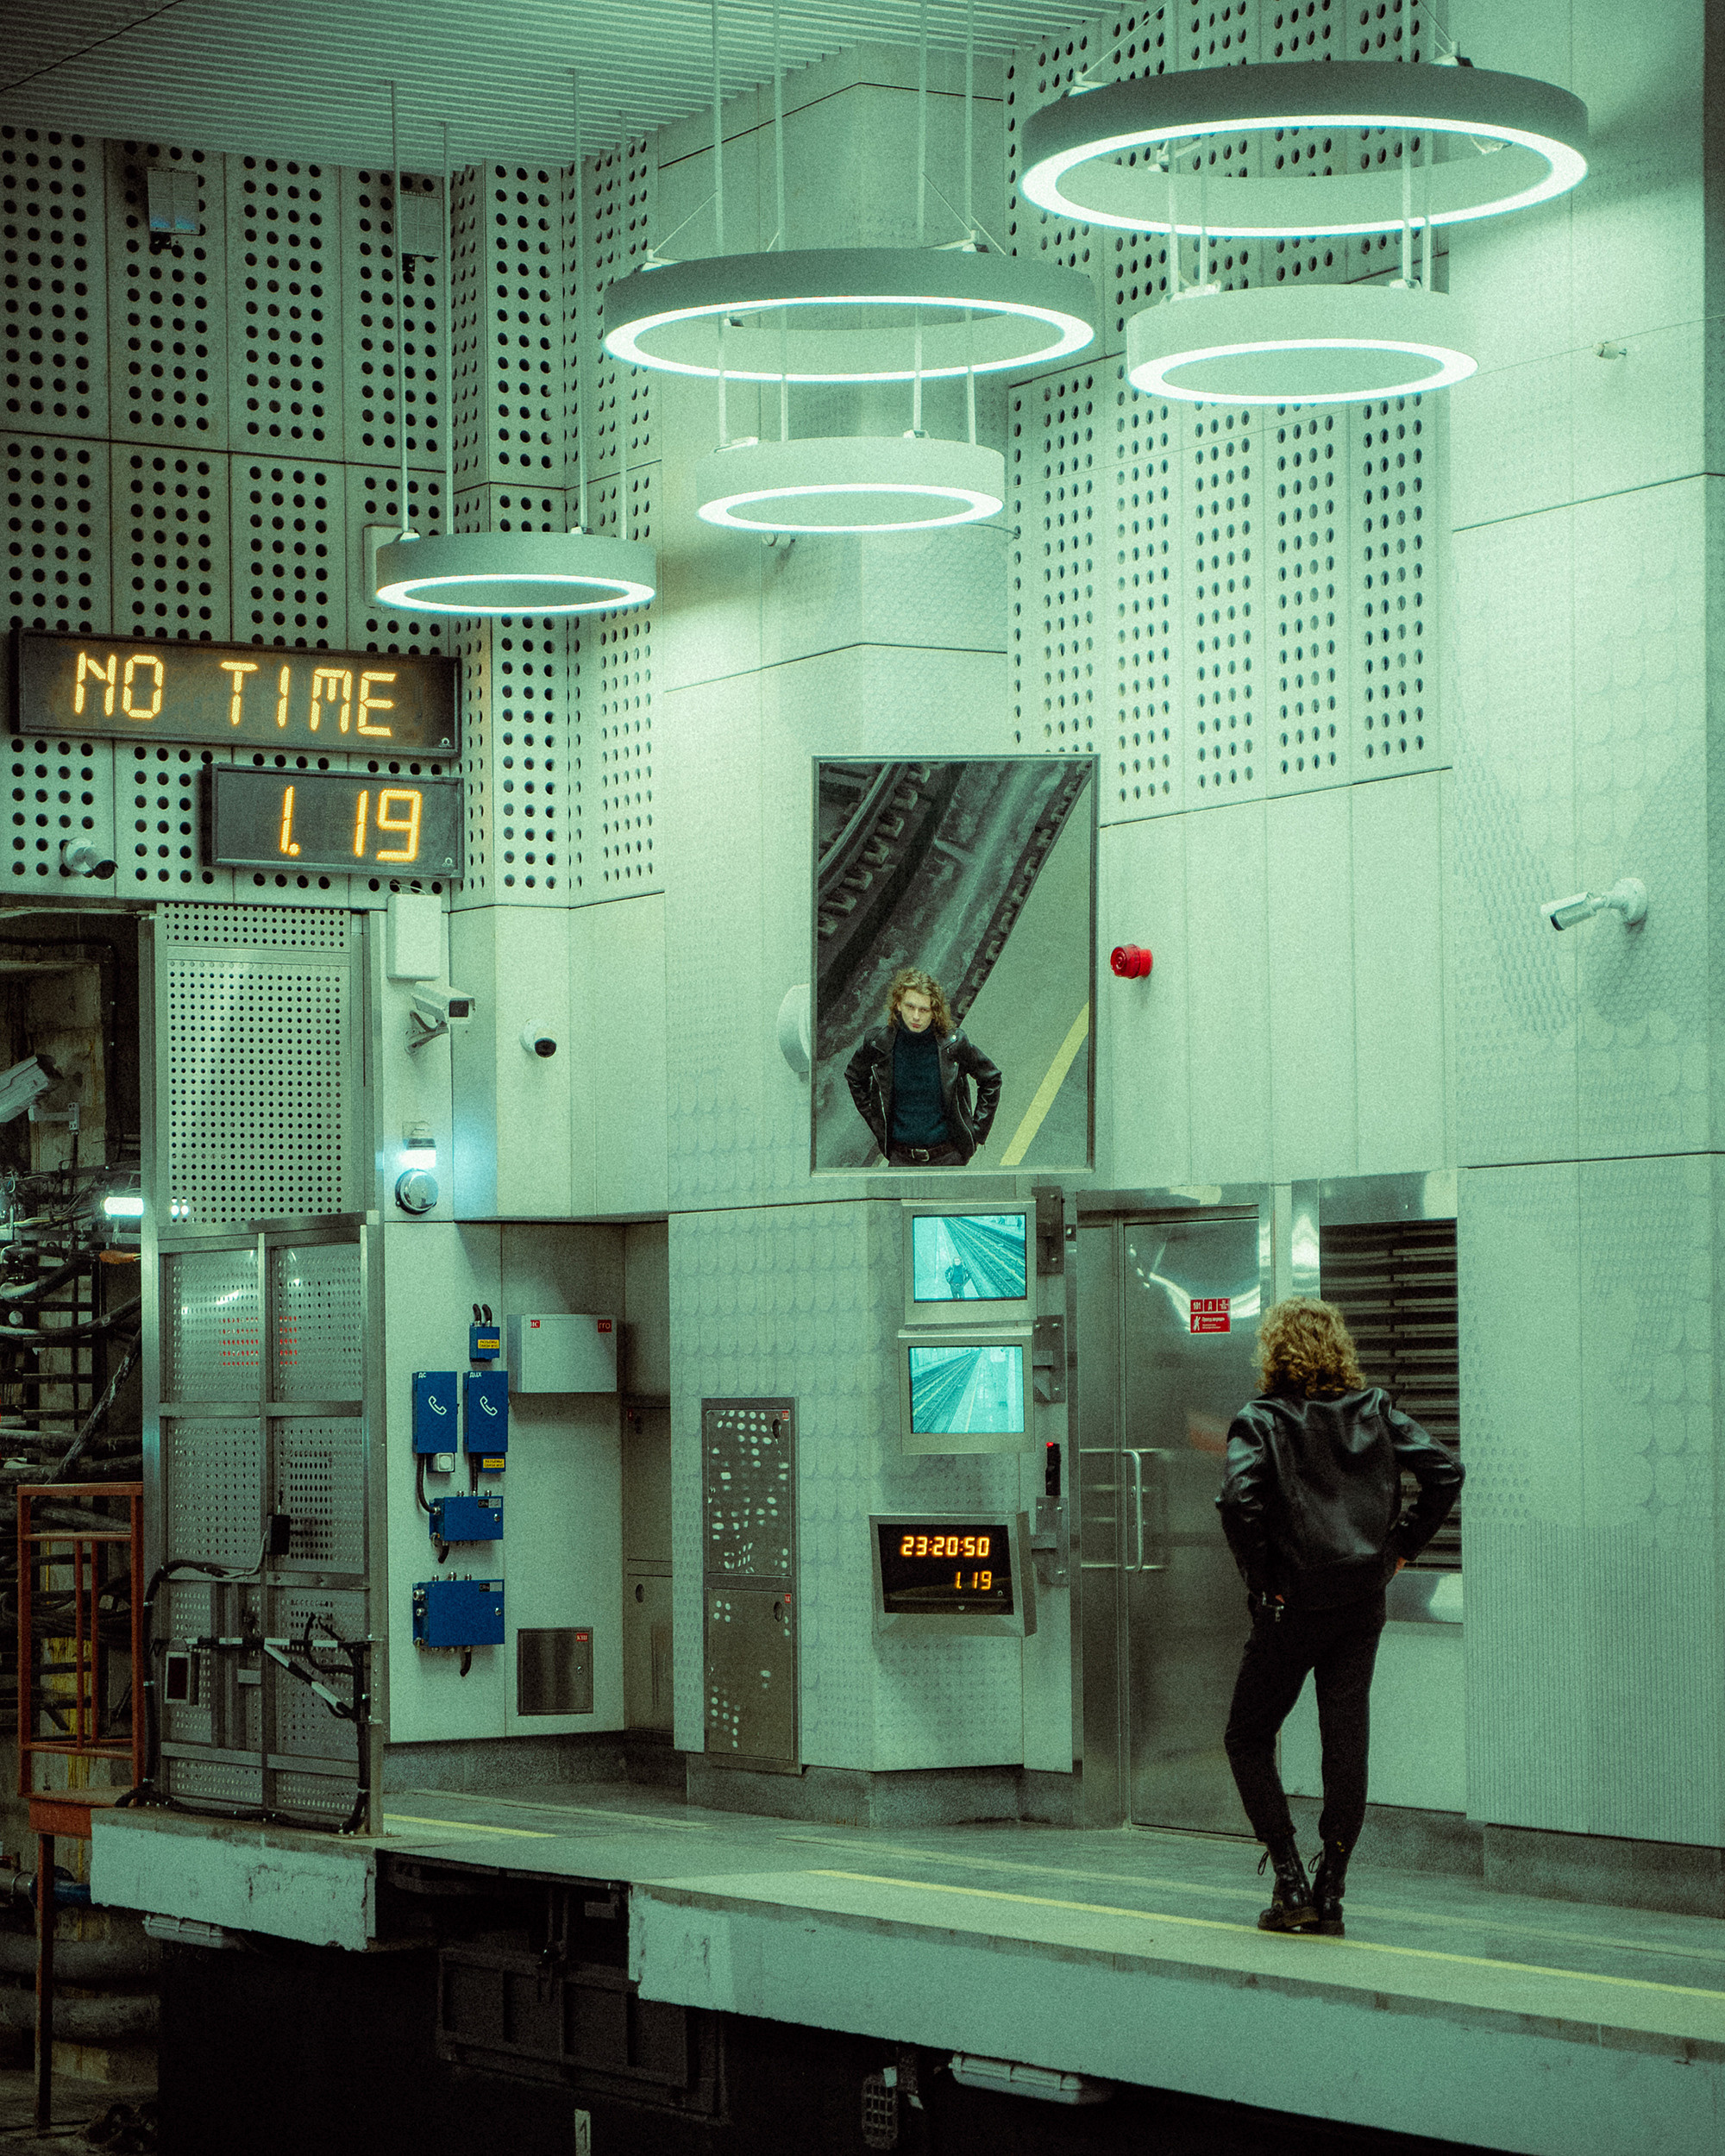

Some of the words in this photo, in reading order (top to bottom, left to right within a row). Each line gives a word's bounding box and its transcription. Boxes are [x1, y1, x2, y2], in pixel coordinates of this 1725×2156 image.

[74, 652, 164, 719] NO
[221, 661, 397, 737] TIME
[354, 789, 423, 862] 19
[900, 1536, 990, 1557] 23:20:50
